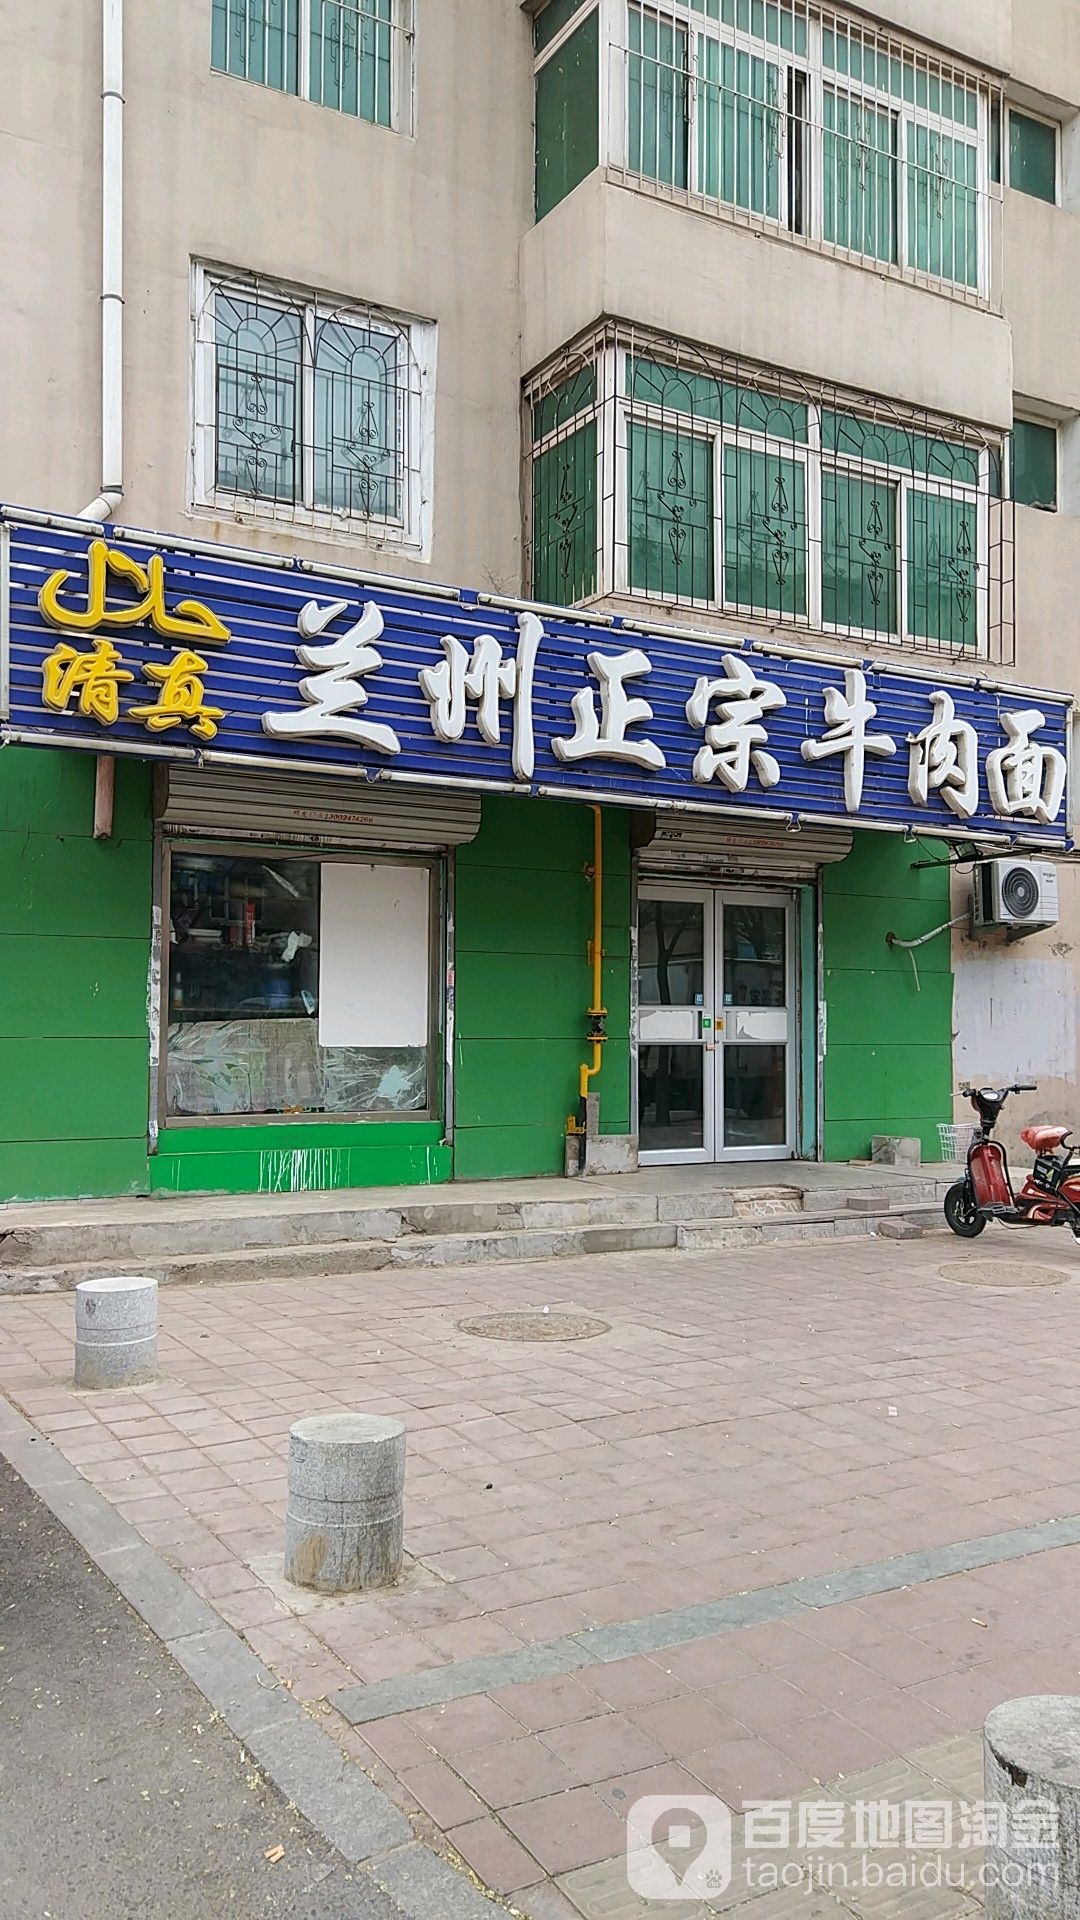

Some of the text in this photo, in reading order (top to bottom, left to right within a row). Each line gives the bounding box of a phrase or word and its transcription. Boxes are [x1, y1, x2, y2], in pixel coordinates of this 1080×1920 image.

[42, 638, 226, 741] 清真
[261, 599, 1067, 826] 兰州正宗牛肉面
